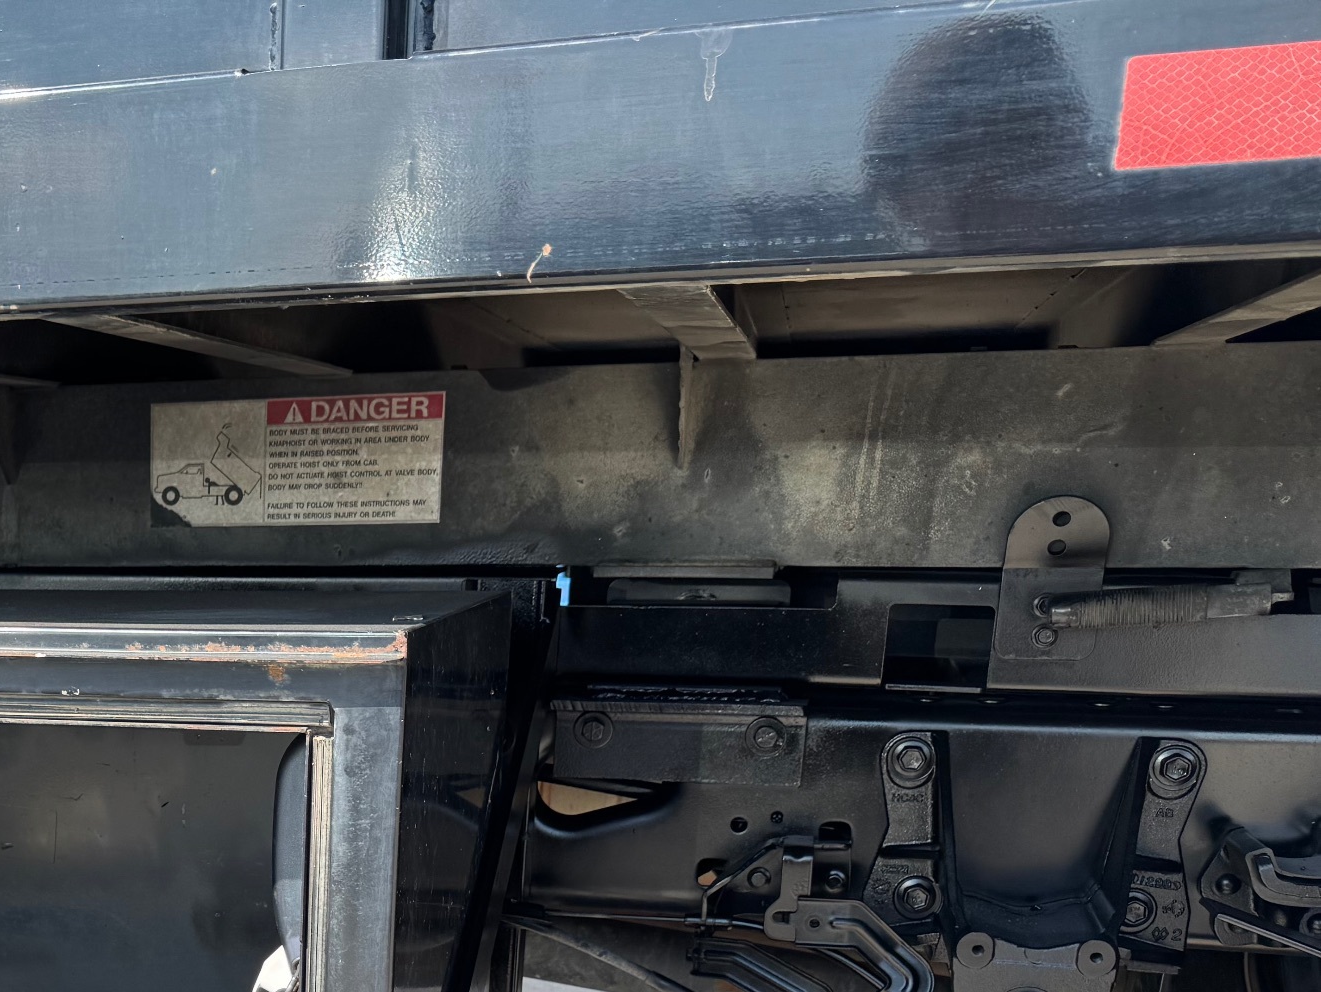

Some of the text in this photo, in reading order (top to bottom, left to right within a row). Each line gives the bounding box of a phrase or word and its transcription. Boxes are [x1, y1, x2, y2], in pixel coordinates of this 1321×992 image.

[311, 397, 428, 422] DANGER
[290, 428, 308, 436] MUST
[382, 424, 418, 432] SERVICING
[268, 440, 306, 448] KNAPHOIST
[321, 438, 352, 446] WORKING
[327, 448, 359, 456] POSITION.
[350, 470, 382, 478] CONTROL
[418, 468, 438, 476] BODY,
[324, 482, 362, 490] SUDDENLY!!
[268, 502, 293, 510] FAILURE
[306, 501, 334, 509] FOLLOW
